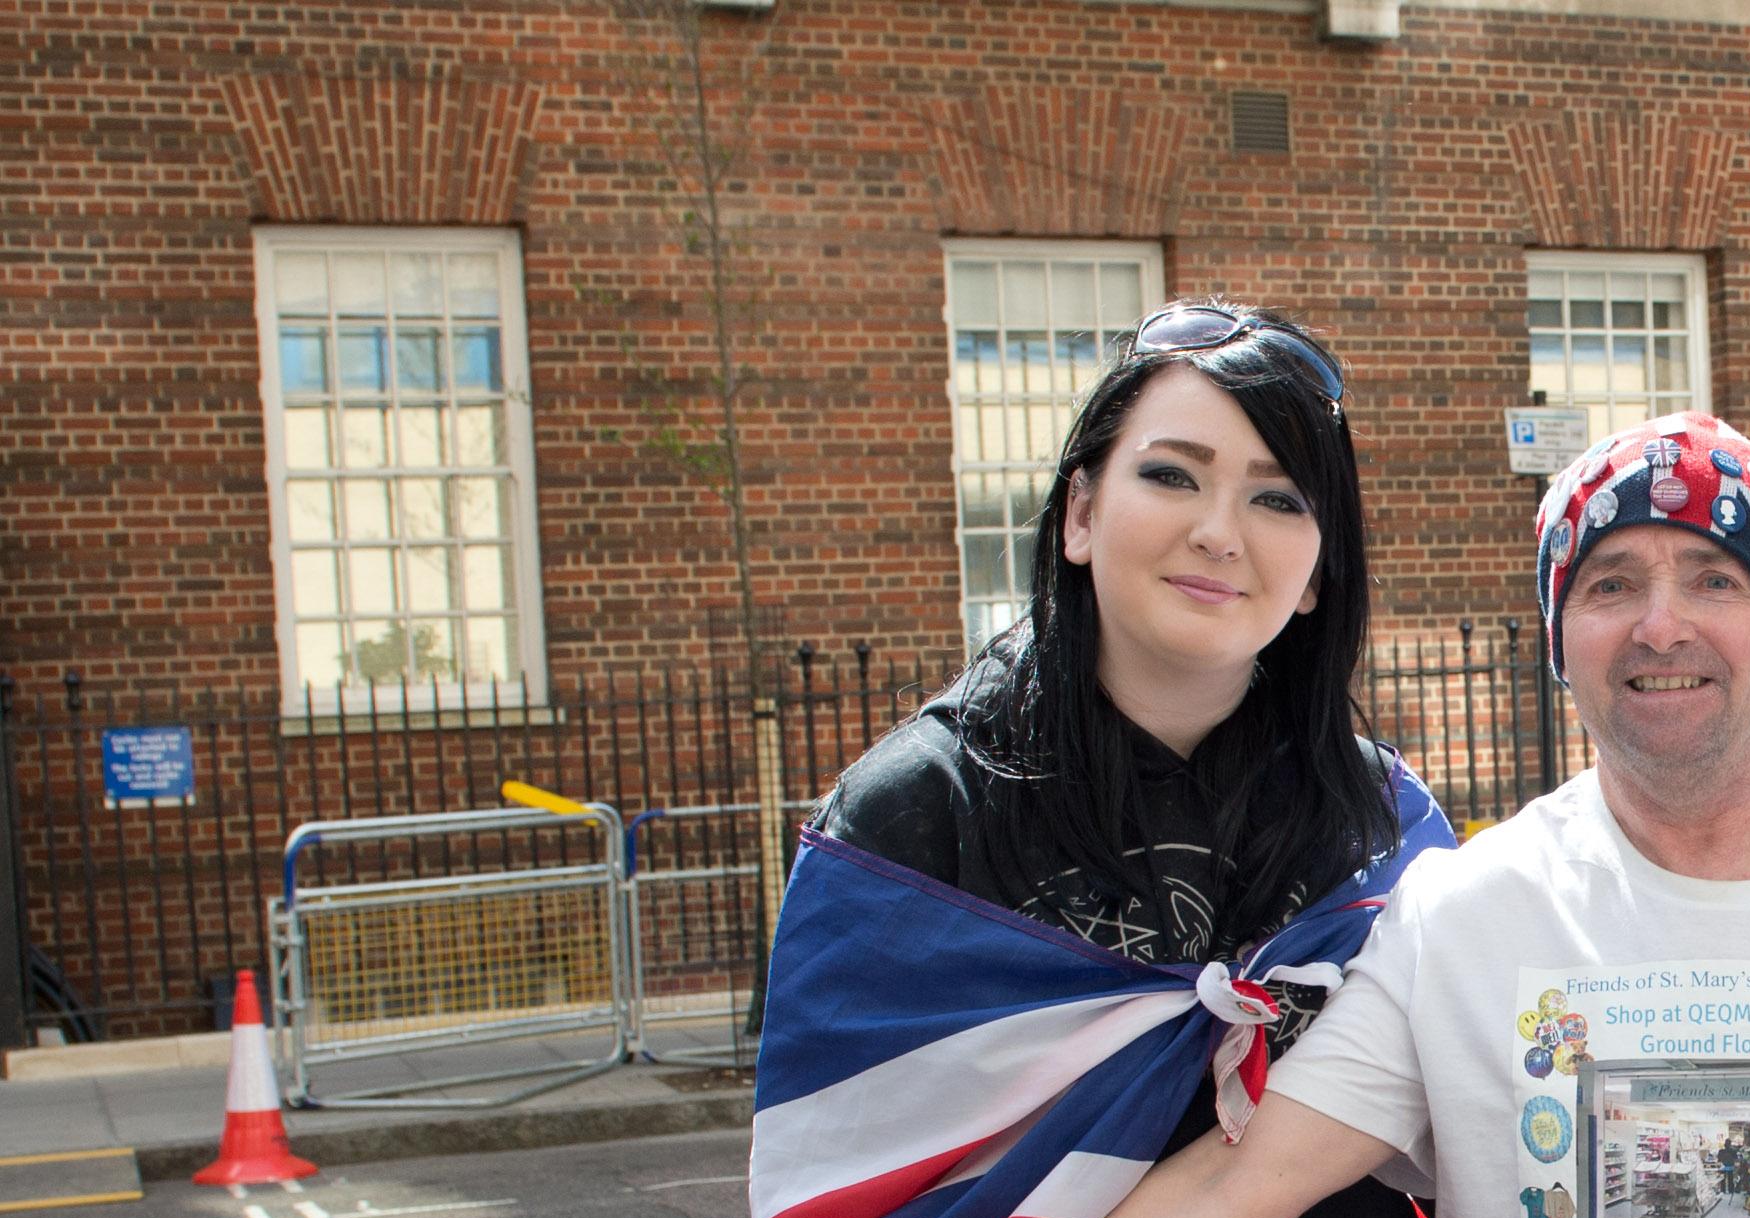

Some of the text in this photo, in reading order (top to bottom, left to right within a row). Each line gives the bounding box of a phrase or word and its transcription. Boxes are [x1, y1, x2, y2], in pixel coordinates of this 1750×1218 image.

[1566, 975, 1630, 996] Friends
[1635, 971, 1656, 989] of
[1660, 970, 1684, 989] St.
[1605, 1004, 1656, 1028] Shop
[1661, 1004, 1682, 1023] at
[1640, 1032, 1714, 1054] Ground
[1657, 1083, 1715, 1098] Friends
